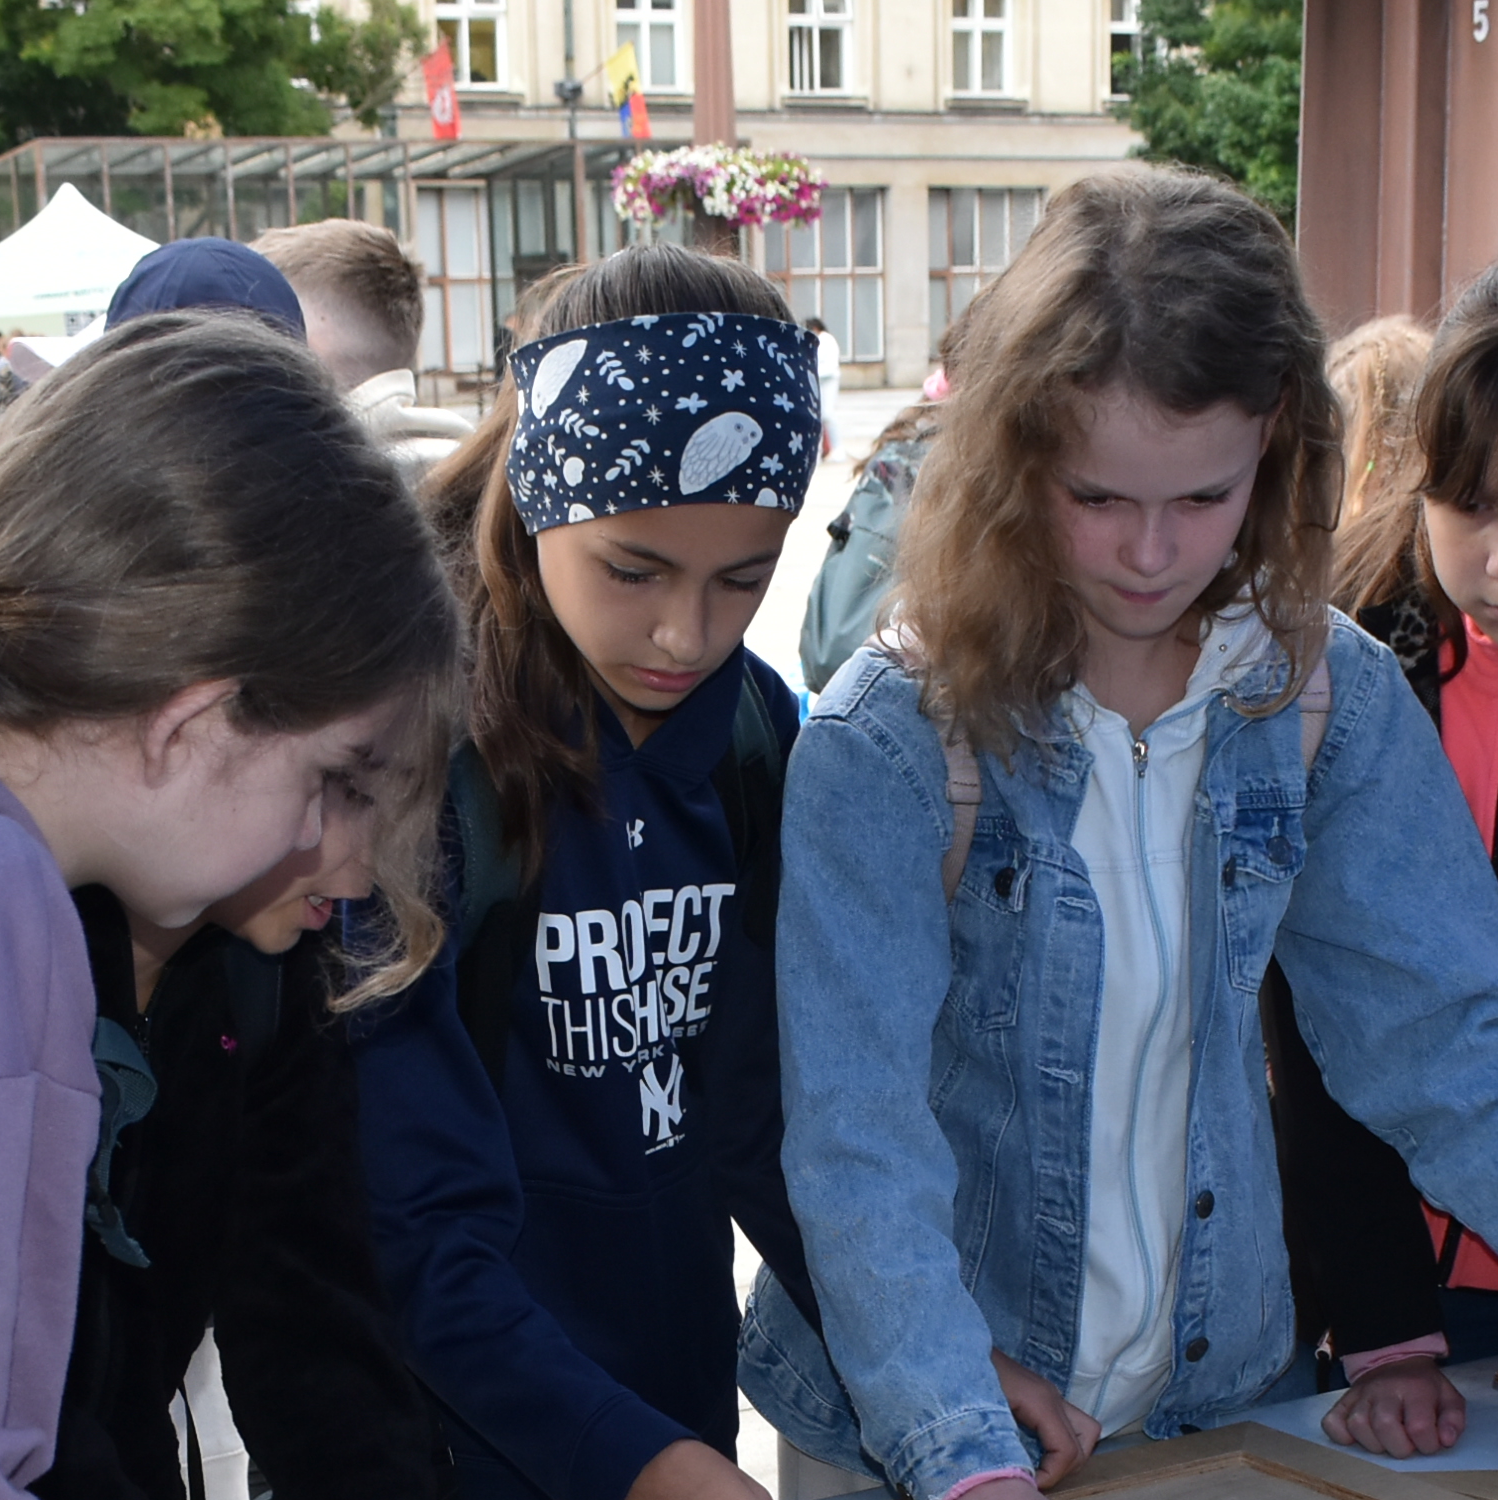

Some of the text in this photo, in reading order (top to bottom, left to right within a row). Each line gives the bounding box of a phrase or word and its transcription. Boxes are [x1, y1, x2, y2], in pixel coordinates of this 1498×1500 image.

[1472, 0, 1490, 43] 5
[535, 883, 736, 994] PROECT
[540, 993, 637, 1060] THIS
[545, 1044, 664, 1078] NEW YRK
